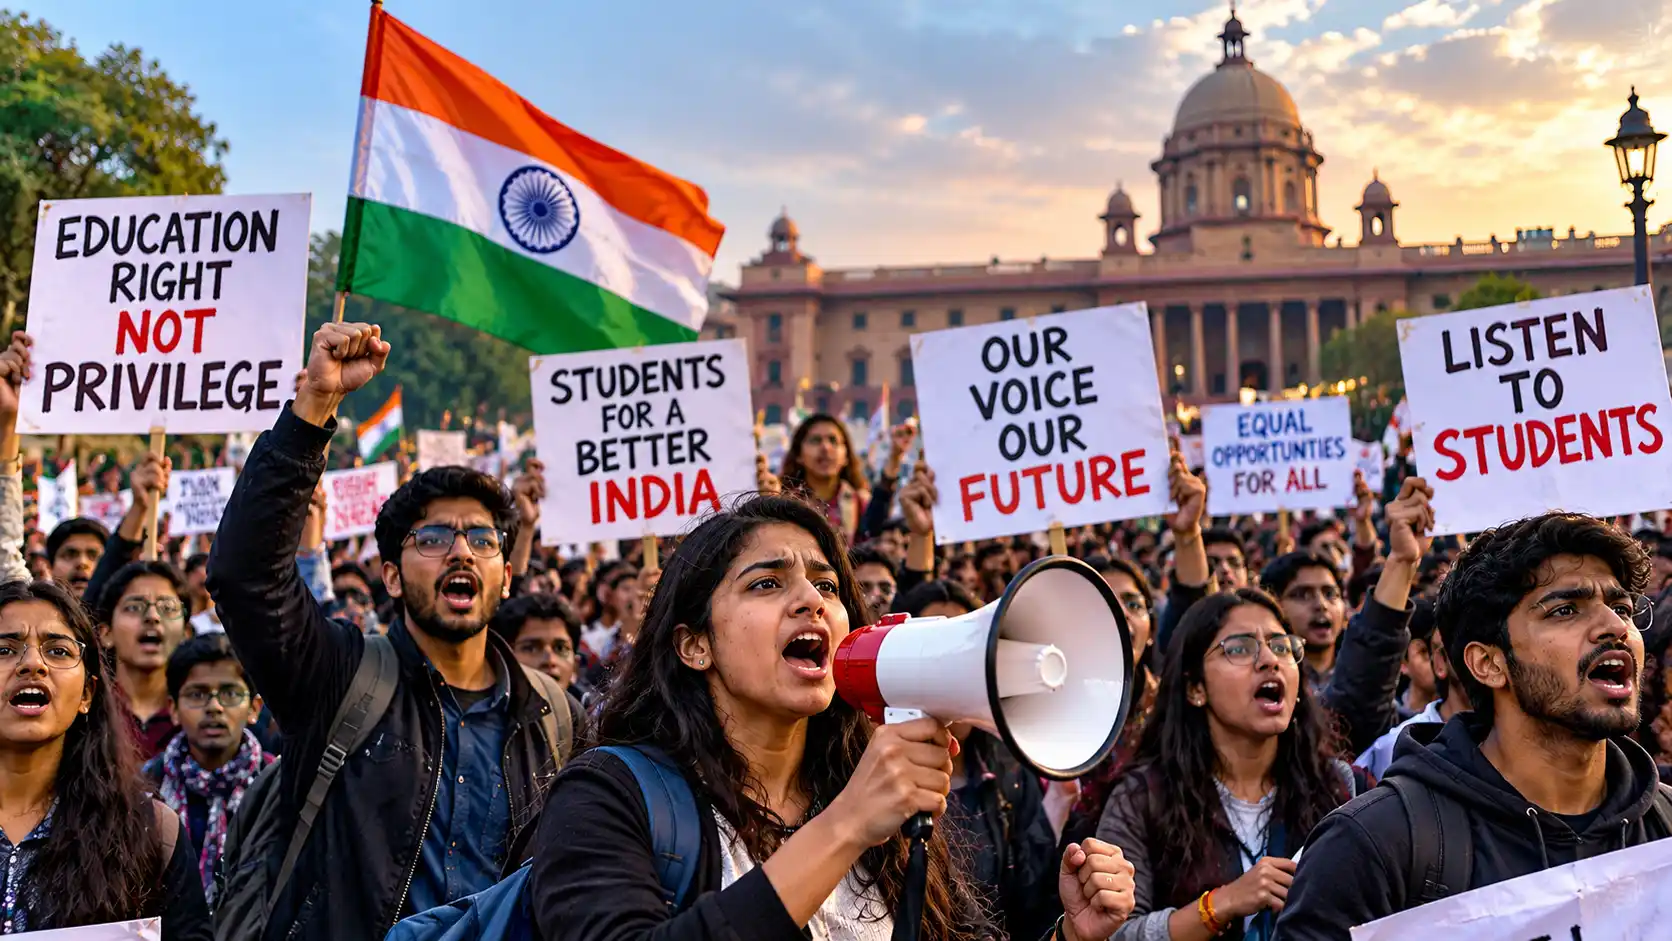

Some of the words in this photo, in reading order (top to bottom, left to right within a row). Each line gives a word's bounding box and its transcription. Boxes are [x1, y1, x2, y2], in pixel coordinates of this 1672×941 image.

[54, 208, 280, 261] EDUCATION
[109, 259, 233, 304] RIGHT
[115, 307, 218, 356] NOT
[980, 325, 1074, 375] OUR
[1441, 306, 1608, 375] LISTEN
[41, 359, 284, 414] PRIVILEGE
[550, 353, 726, 405] STUDENTS
[968, 364, 1100, 422] VOICE
[1498, 366, 1565, 415] TO
[601, 401, 654, 433] FOR
[665, 397, 686, 427] A
[998, 413, 1089, 463] OUR
[1237, 407, 1314, 440] EQUAL
[576, 428, 711, 476] BETTER
[1211, 435, 1347, 468] OPPORTUNTIES
[1432, 402, 1665, 482] STUDENTS
[589, 468, 722, 524] INDIA
[957, 447, 1152, 524] FUTURE
[1233, 468, 1277, 498] FOR
[1285, 465, 1329, 494] ALL
